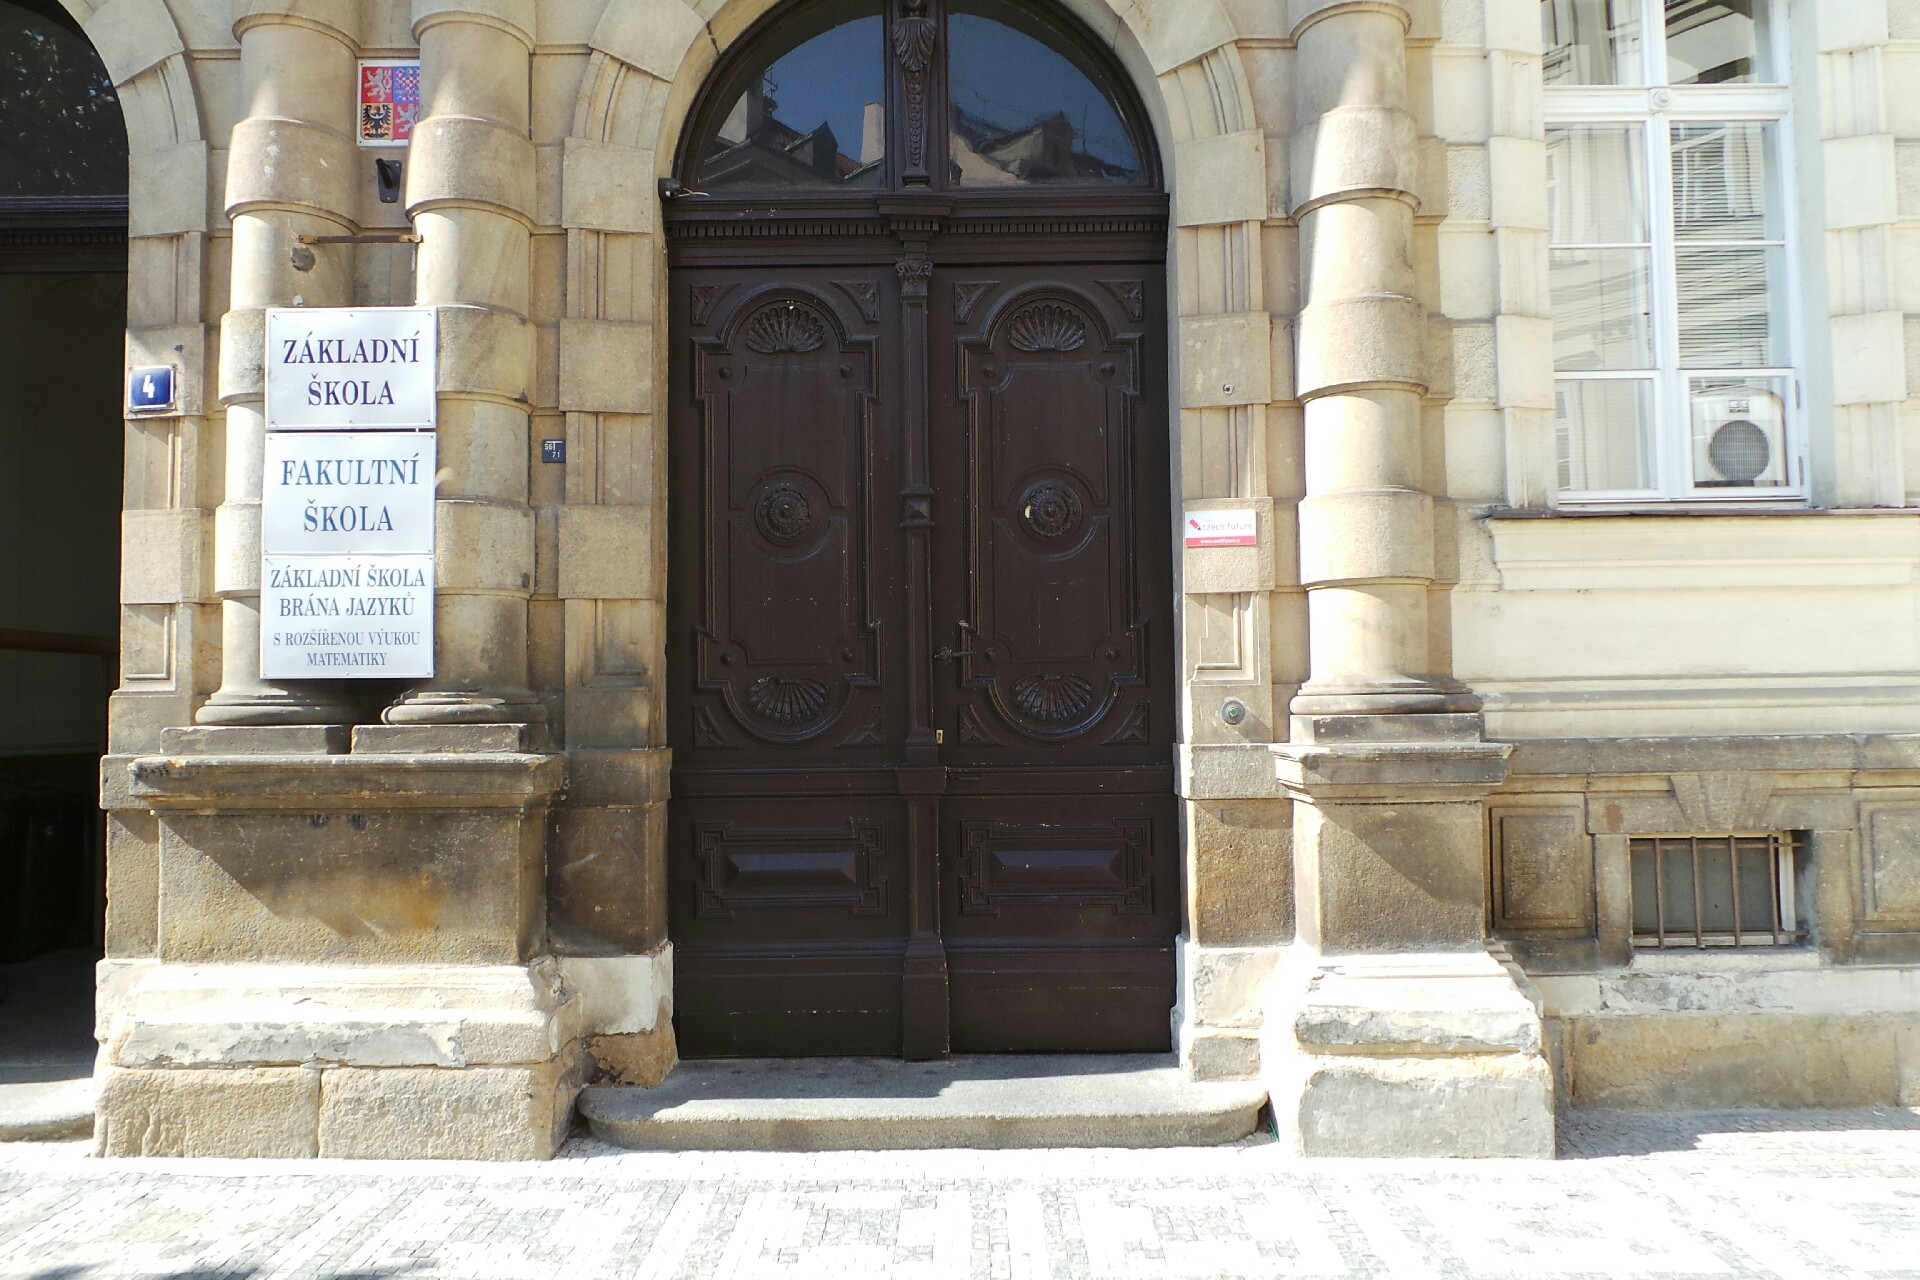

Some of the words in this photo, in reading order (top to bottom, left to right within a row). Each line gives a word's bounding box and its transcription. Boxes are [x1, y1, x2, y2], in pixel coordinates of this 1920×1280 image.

[283, 330, 420, 364] ZÁKLADNÍ
[142, 374, 155, 399] 4
[308, 373, 395, 406] ŠKOLA
[281, 453, 419, 486] FAKULTNÍ
[304, 499, 394, 533] ŠKOLA
[270, 564, 362, 589] ZÁKLADNÍ
[366, 564, 426, 588] ŠKOLA
[279, 592, 341, 617] BRÁNA
[345, 591, 415, 617] JAZYKŮ
[273, 632, 281, 647] S
[285, 628, 364, 647] ROZŠÍŘENOU
[369, 628, 420, 647] VÝUKOU
[306, 652, 387, 667] MATEMATIKY
